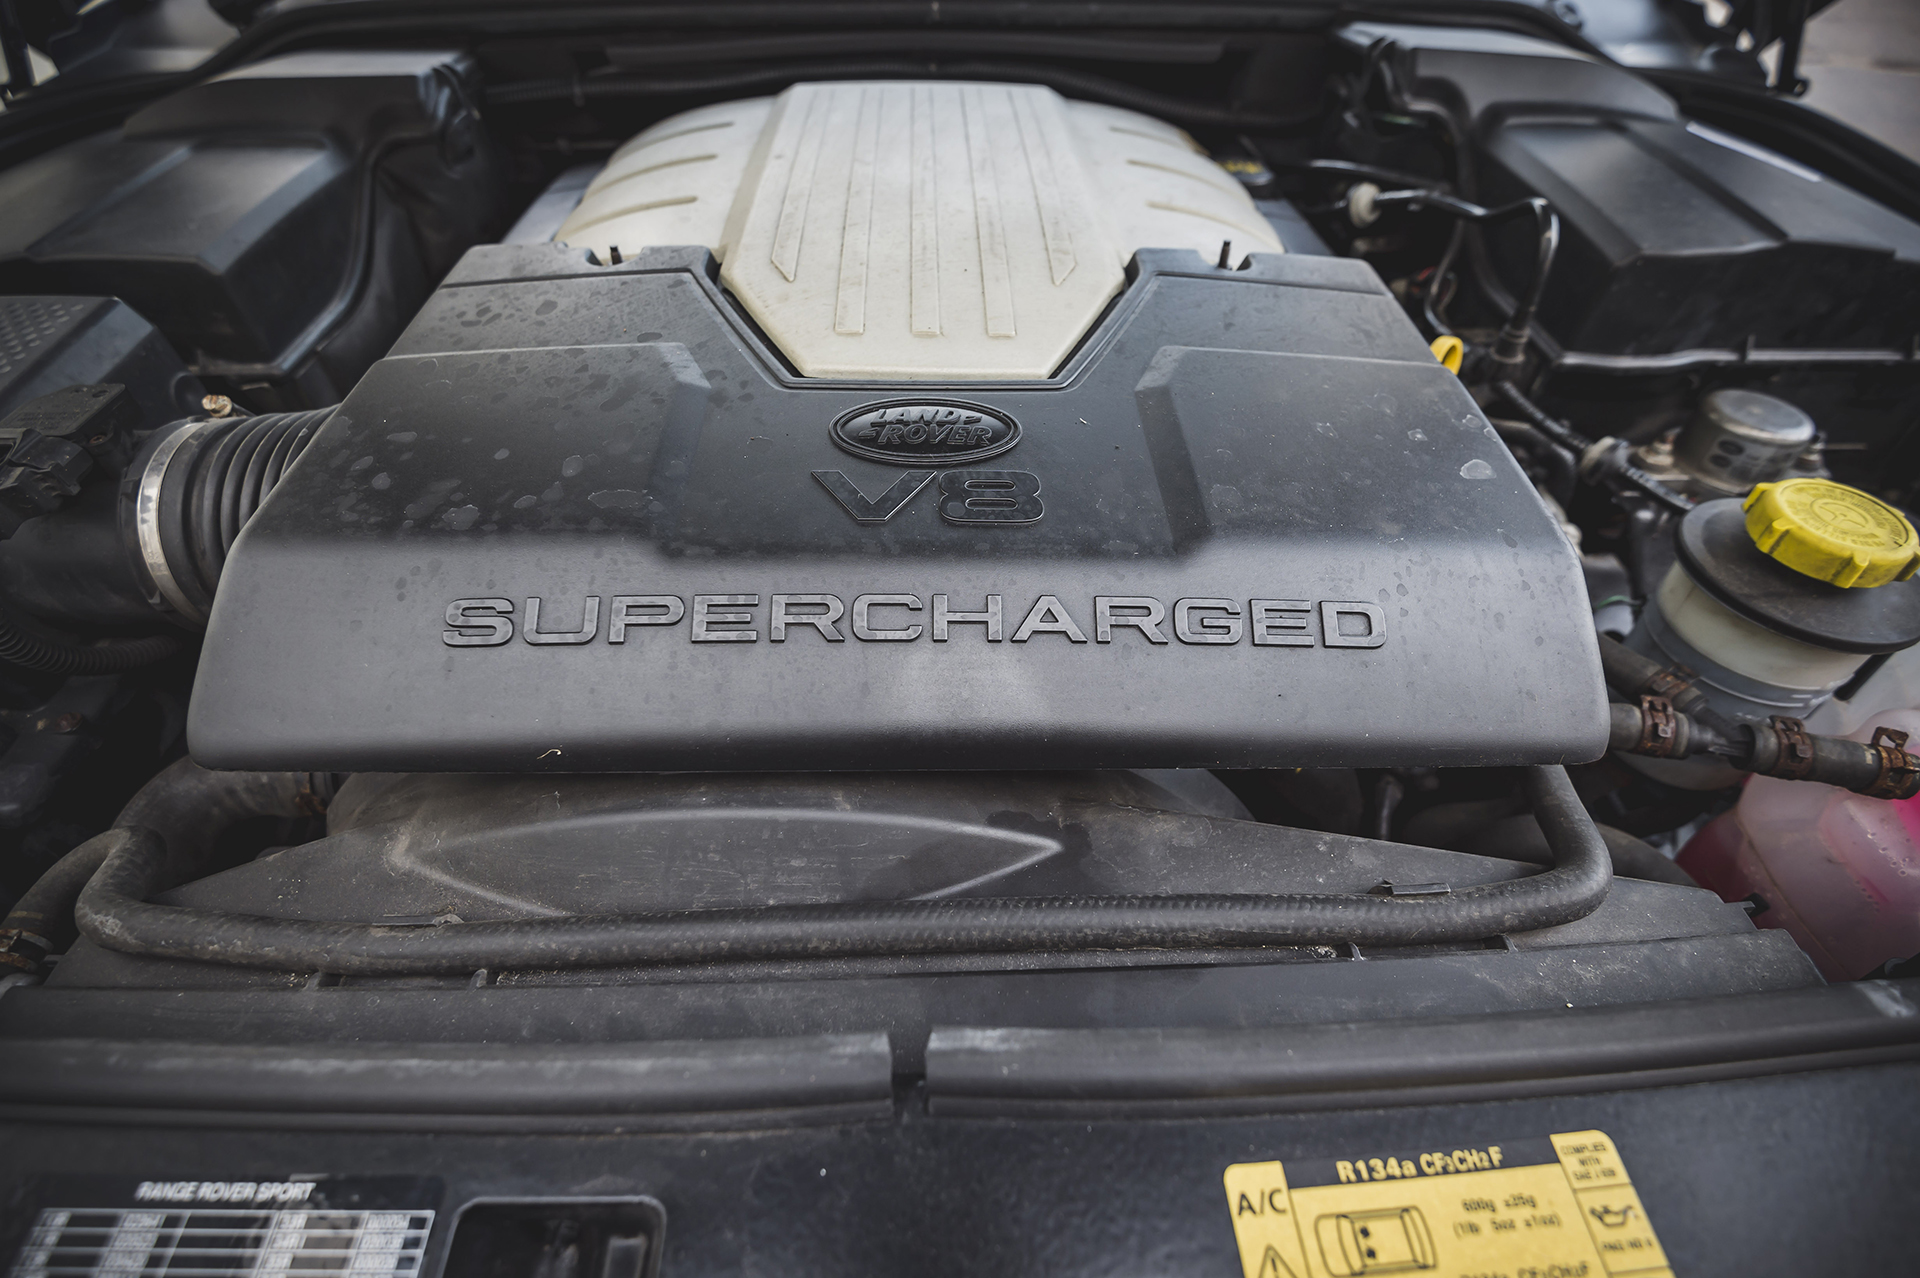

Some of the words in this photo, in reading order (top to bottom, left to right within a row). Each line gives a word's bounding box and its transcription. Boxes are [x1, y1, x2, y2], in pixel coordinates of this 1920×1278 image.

[870, 408, 962, 425] LAND
[877, 424, 993, 445] ROVER
[811, 470, 1045, 524] V8
[441, 591, 1388, 650] SUPERCHARGED
[1336, 1157, 1418, 1184] R134a
[135, 1181, 199, 1201] RANGE
[198, 1181, 257, 1201] ROVER
[256, 1182, 317, 1202] SPORT
[1237, 1188, 1288, 1217] A/C
